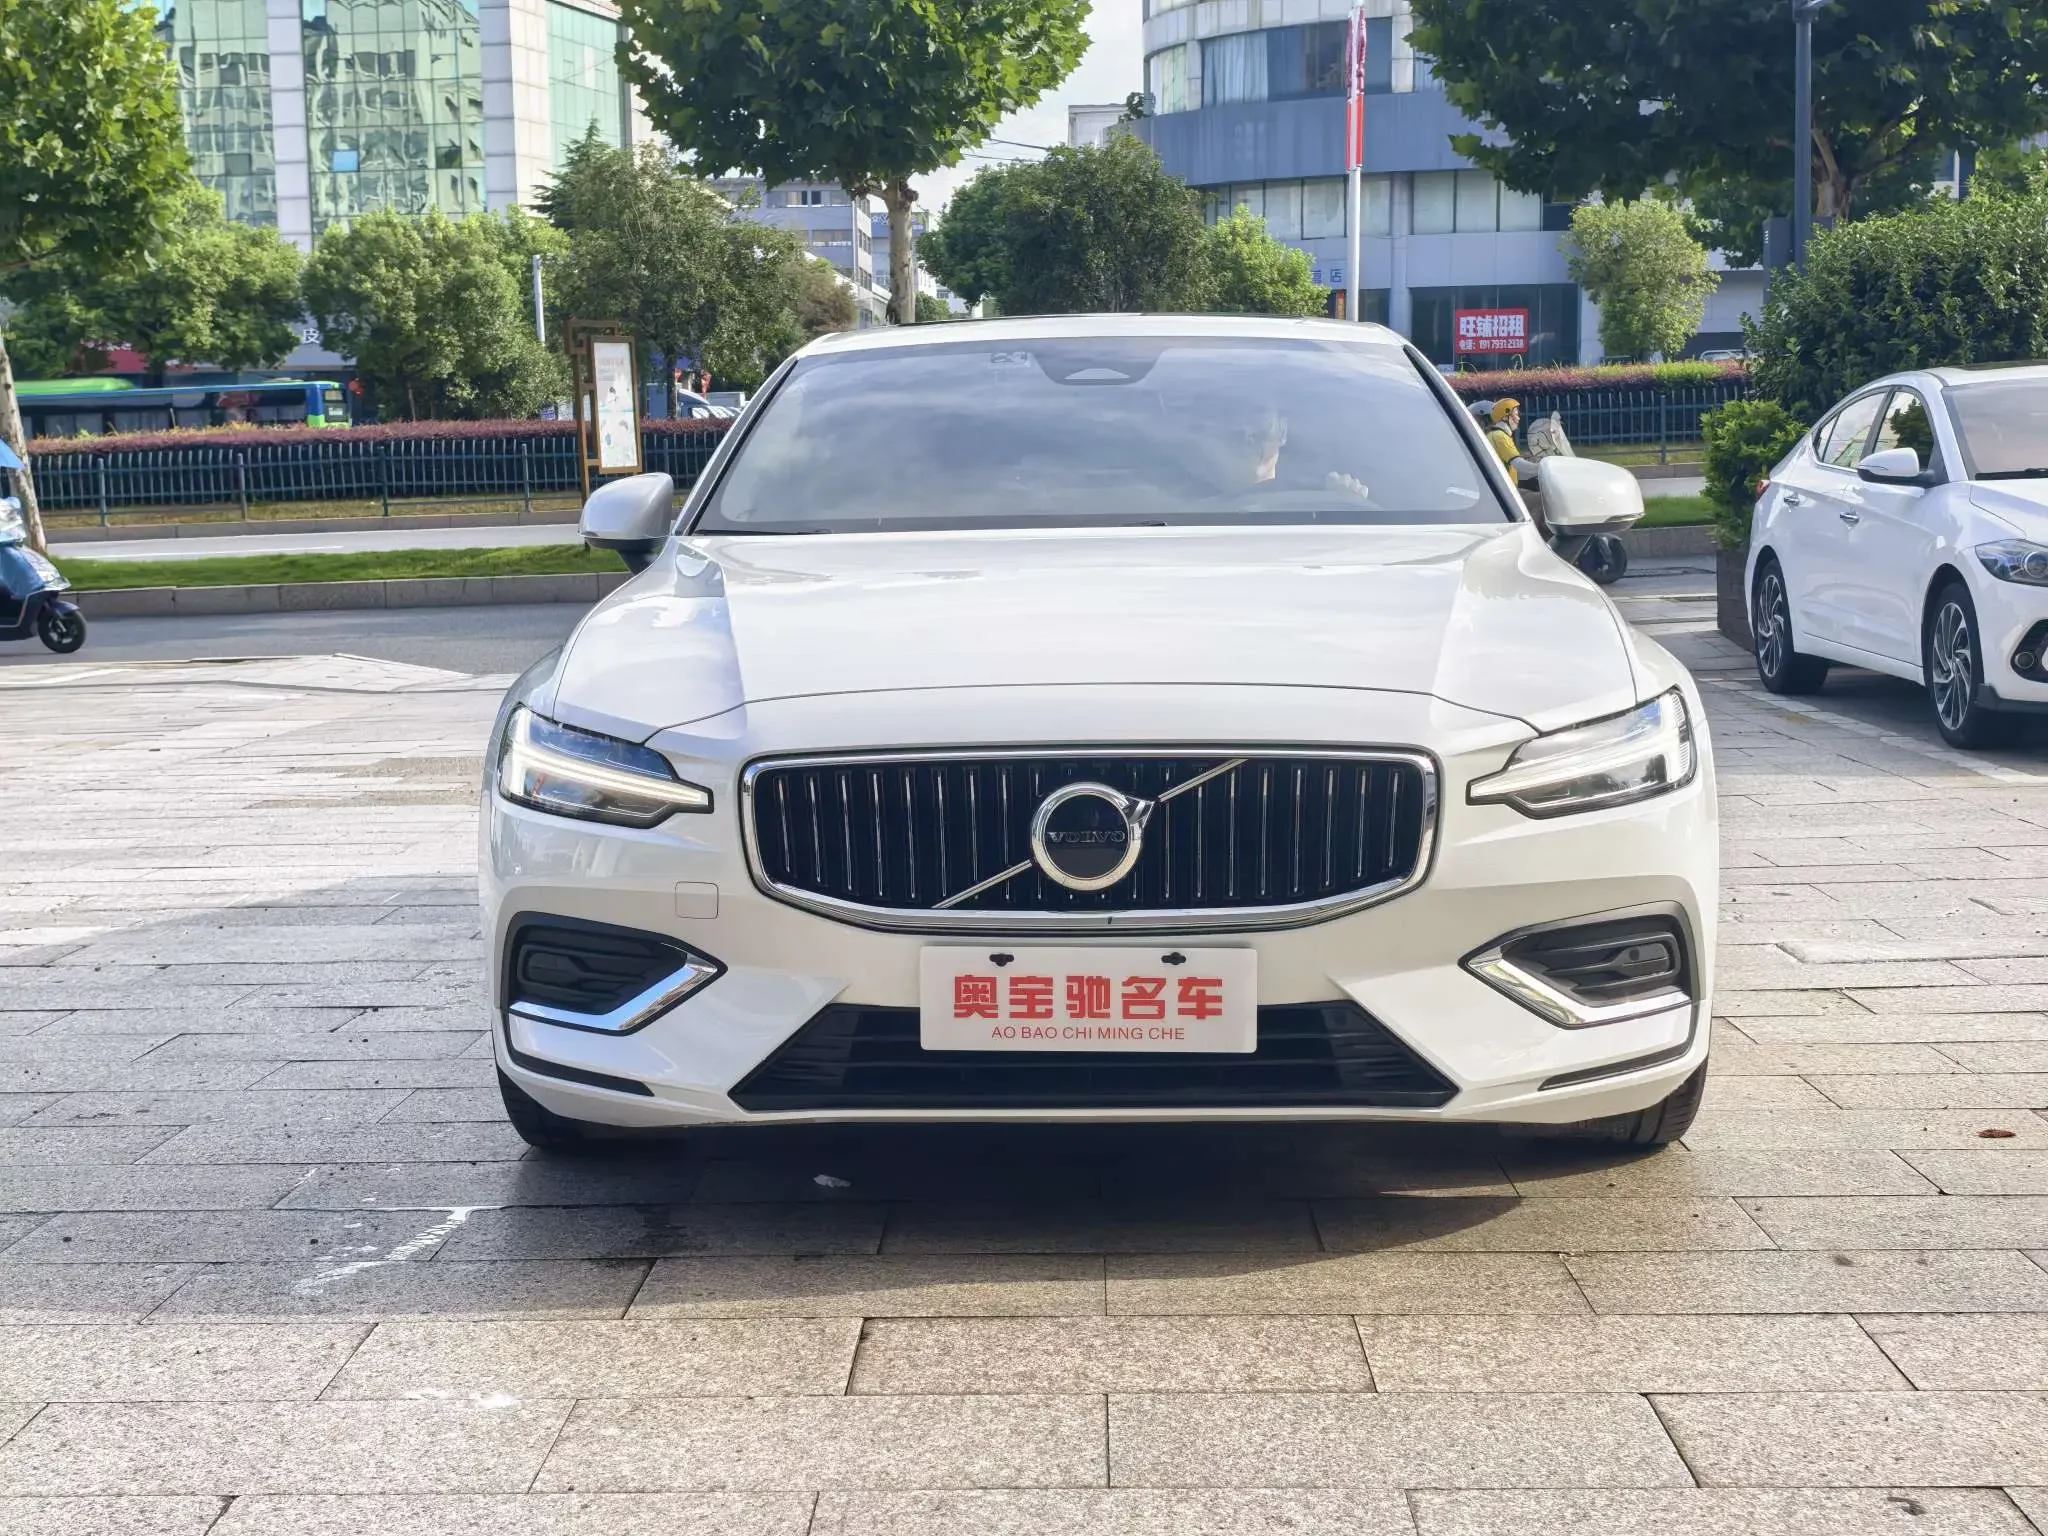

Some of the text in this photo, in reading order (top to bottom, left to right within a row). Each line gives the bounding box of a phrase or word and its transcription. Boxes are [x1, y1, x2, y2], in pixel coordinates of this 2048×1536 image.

[1460, 314, 1525, 337] 旺铺招租
[1046, 830, 1126, 843] VOLVO
[954, 974, 1223, 1020] 奥宝驰名车
[991, 1027, 1185, 1040] AO BAO CHI MING CHE
